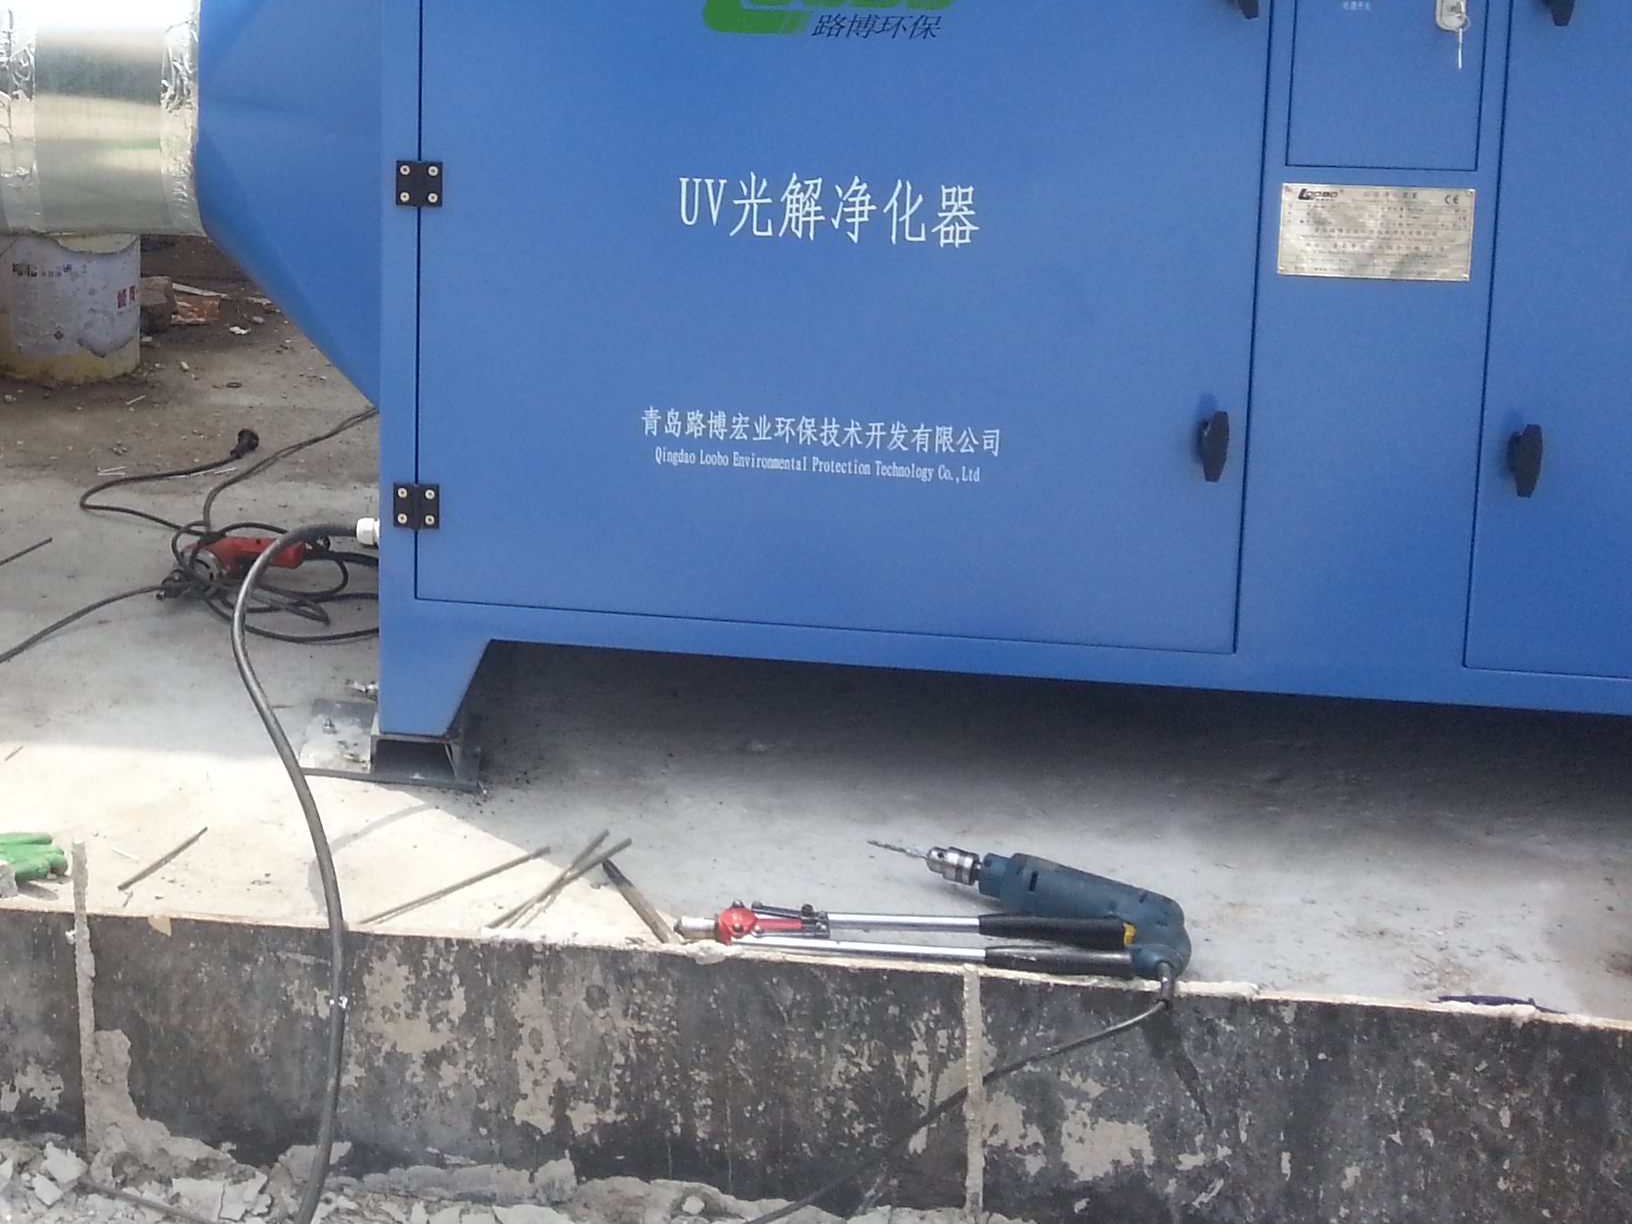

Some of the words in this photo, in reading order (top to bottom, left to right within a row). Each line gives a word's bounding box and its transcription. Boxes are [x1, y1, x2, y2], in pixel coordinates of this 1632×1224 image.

[811, 13, 942, 40] 路博环保
[678, 171, 981, 248] UV光解净化器
[641, 405, 1001, 457] 青岛路博宏业环保技术开发有限公司
[655, 445, 696, 466] Qingdao
[699, 449, 729, 467] Loobo
[732, 450, 807, 472] Environmental
[812, 456, 871, 475] Protection
[875, 460, 934, 482] Technology
